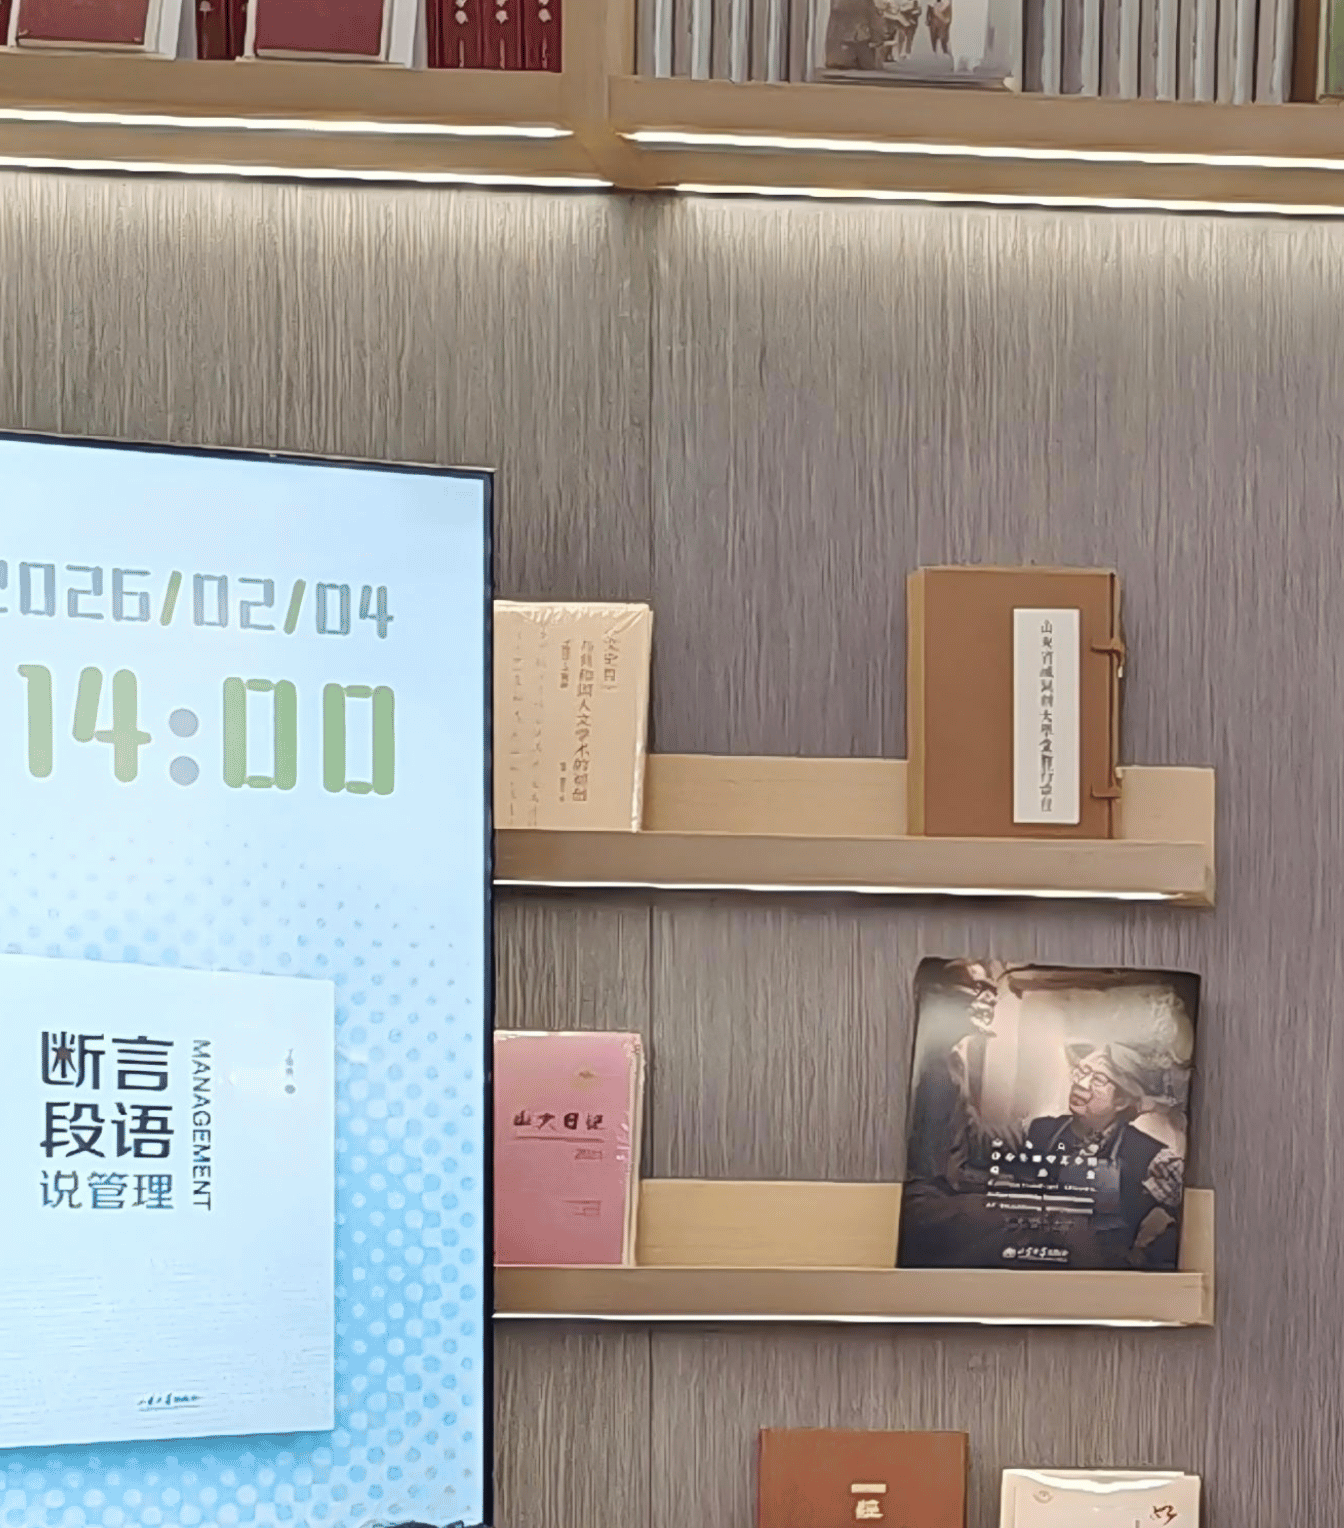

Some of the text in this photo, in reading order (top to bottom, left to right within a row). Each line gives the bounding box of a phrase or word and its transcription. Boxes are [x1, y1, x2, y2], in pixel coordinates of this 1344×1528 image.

[18, 664, 396, 795] 14:00
[41, 1031, 174, 1091] 断言
[40, 1101, 174, 1159] 段语
[191, 1039, 213, 1211] MANAGEMENT
[40, 1170, 174, 1209] 说管理
